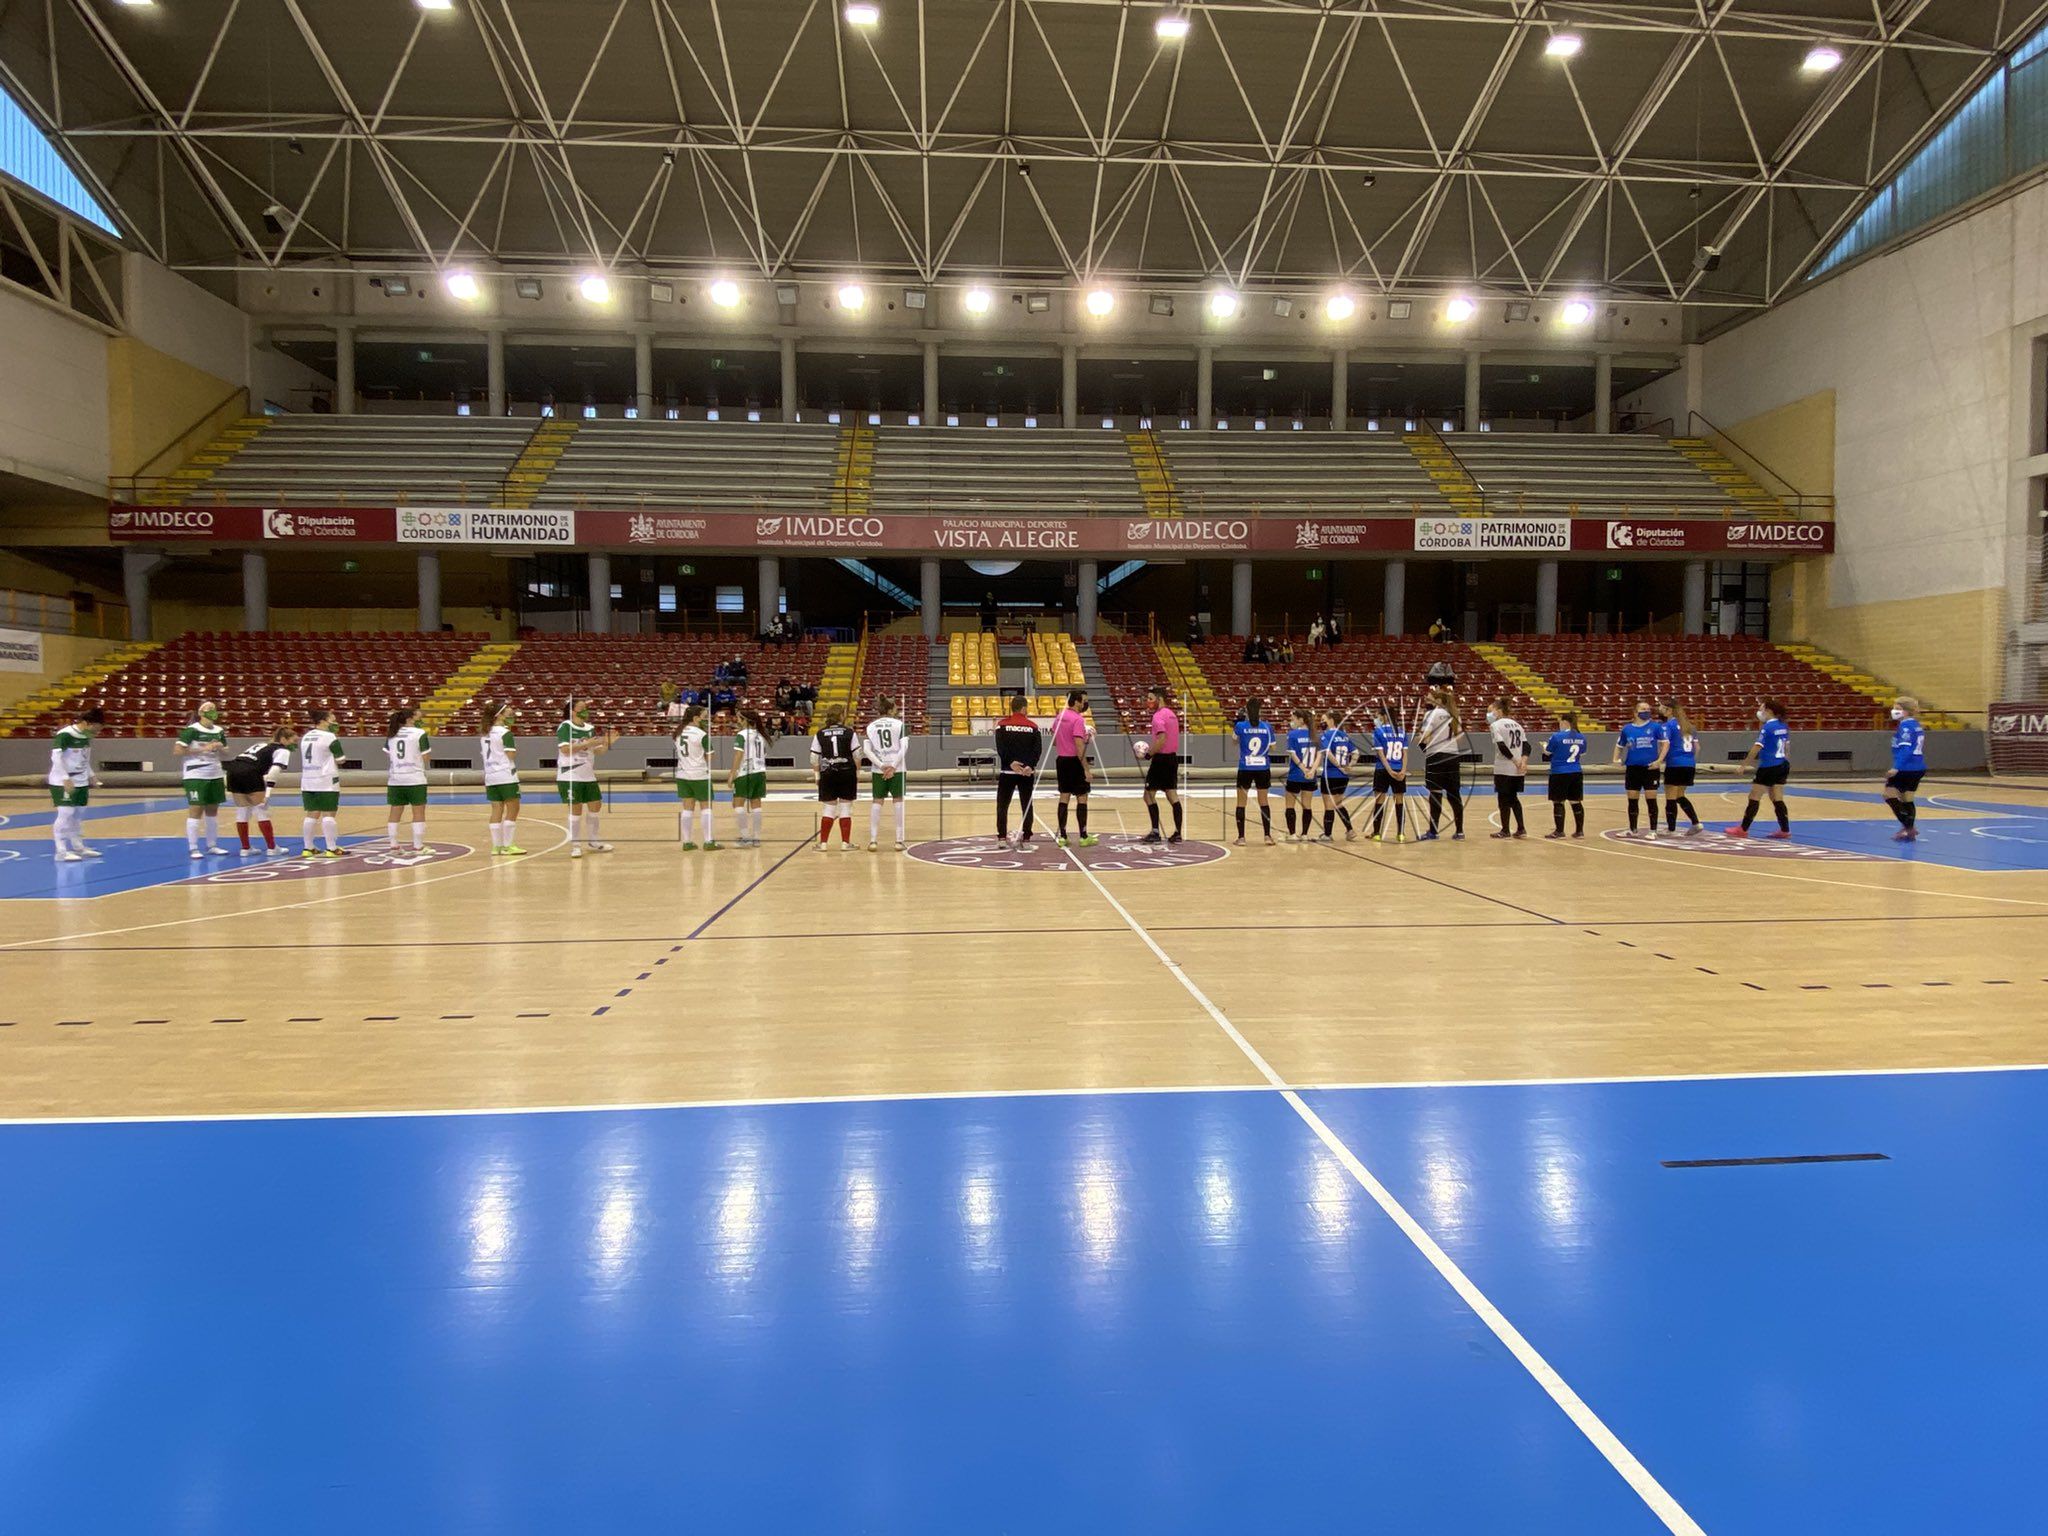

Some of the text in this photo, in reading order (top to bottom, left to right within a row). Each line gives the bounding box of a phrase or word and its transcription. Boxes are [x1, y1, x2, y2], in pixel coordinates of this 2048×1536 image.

[134, 511, 213, 527] IMDECO
[298, 516, 355, 527] Diputación
[471, 513, 558, 526] PATRIMONIO
[656, 519, 706, 529] AYUNTAMIENTO
[786, 517, 884, 537] IMDECO
[980, 520, 1025, 528] MUNICIPAL
[299, 528, 312, 536] de
[471, 527, 569, 541] HUMANIDAD
[656, 530, 666, 538] DE
[1156, 521, 1248, 539] IMDECO
[1320, 525, 1367, 534] AYUNTAMIENTO
[1481, 523, 1557, 534] PATRIMONIO
[1636, 527, 1685, 538] Diputación
[1750, 525, 1824, 541] IMDECO
[934, 530, 1079, 548] VISTA ALEGRE
[1320, 535, 1329, 544] DE
[1419, 536, 1471, 547] CÓRDOBA
[1480, 535, 1566, 547] HUMANIDAD
[1636, 538, 1648, 546] de
[1005, 725, 1034, 733] macron
[680, 735, 689, 757] 5
[831, 736, 839, 757] 1
[877, 729, 892, 749] 19
[1248, 736, 1262, 756] 9
[1509, 730, 1521, 749] 28
[1683, 734, 1693, 752] 8
[304, 743, 313, 764] 4
[396, 739, 405, 760] 9
[485, 739, 491, 760] 7
[1301, 747, 1317, 768] 11
[1386, 741, 1403, 760] 18
[1566, 744, 1580, 763] 2
